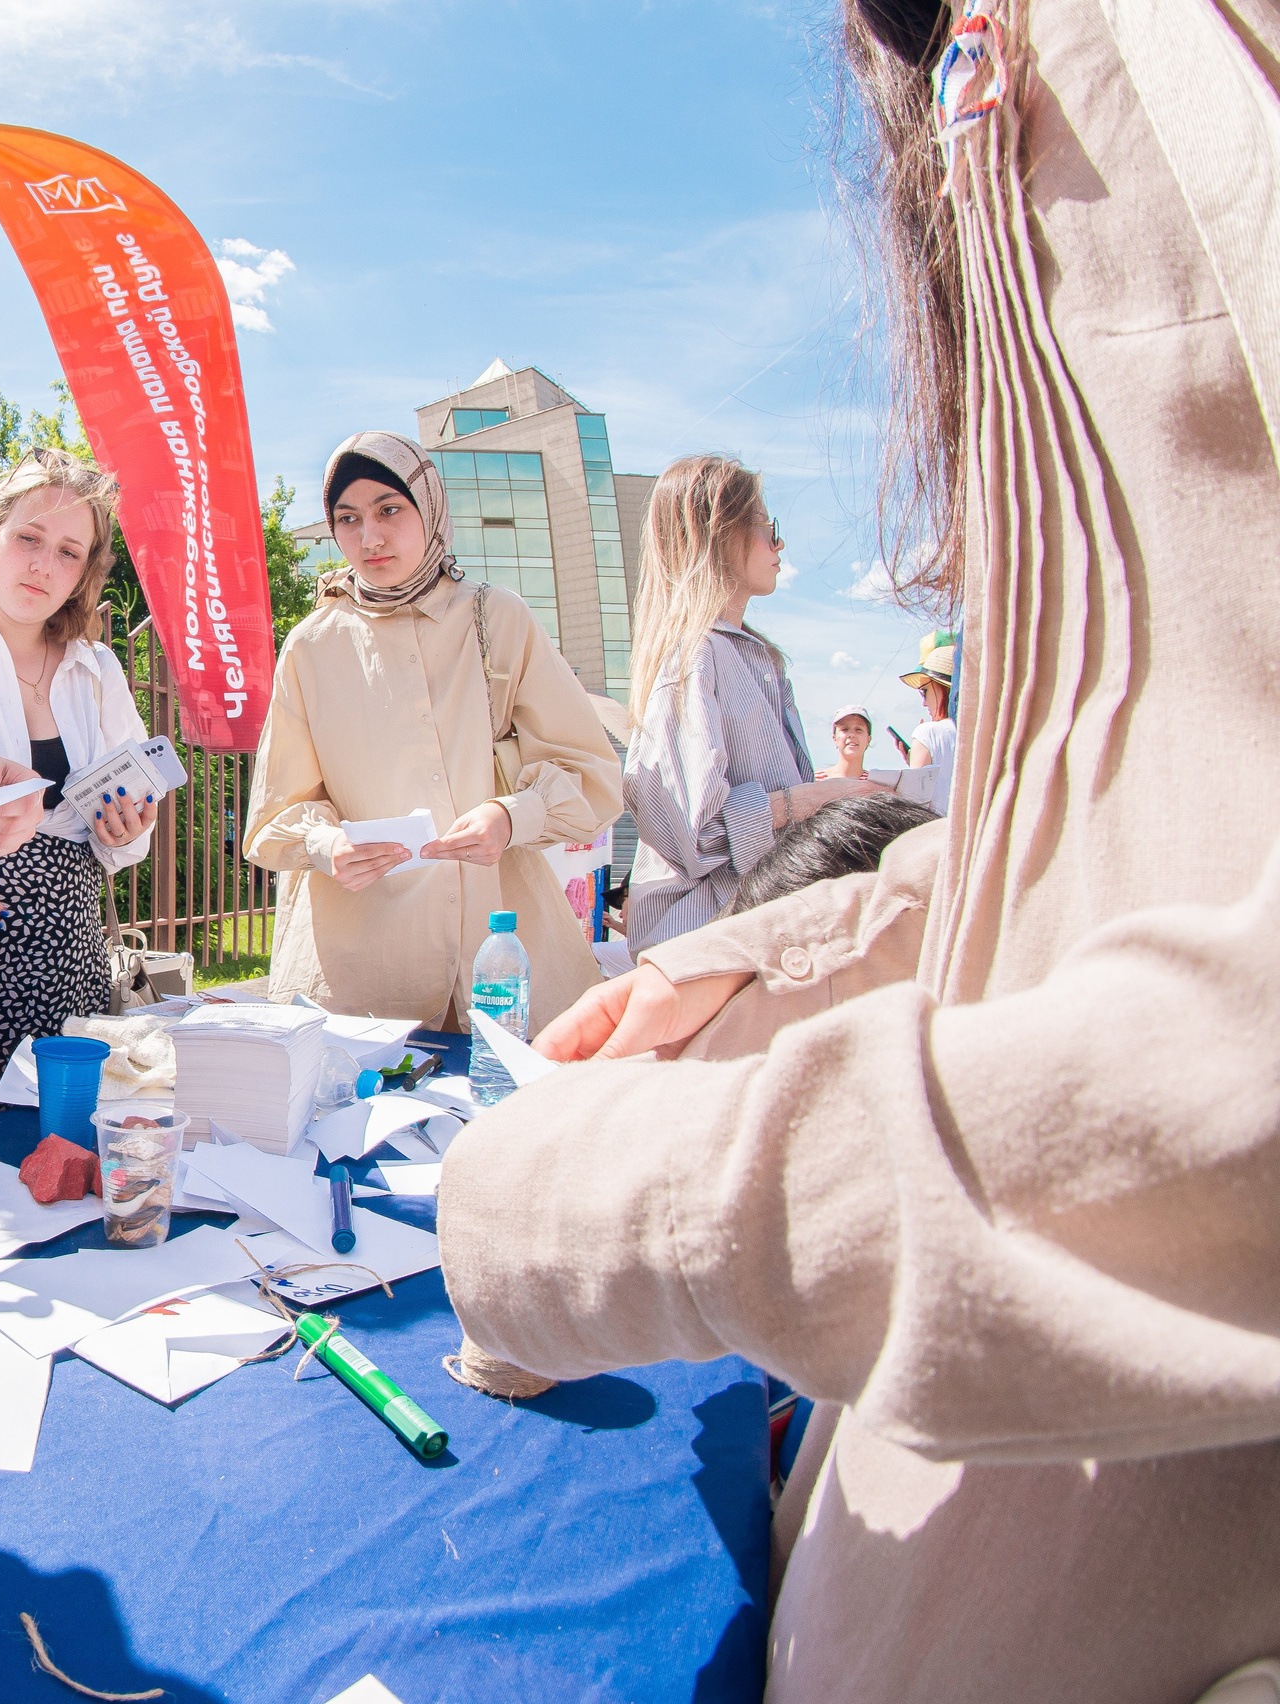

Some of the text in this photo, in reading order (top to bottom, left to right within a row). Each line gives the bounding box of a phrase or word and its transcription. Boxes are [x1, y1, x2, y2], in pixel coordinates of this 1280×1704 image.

[93, 264, 206, 671] Молодёжная палата при
[115, 232, 248, 719] Челябинской городской Думе
